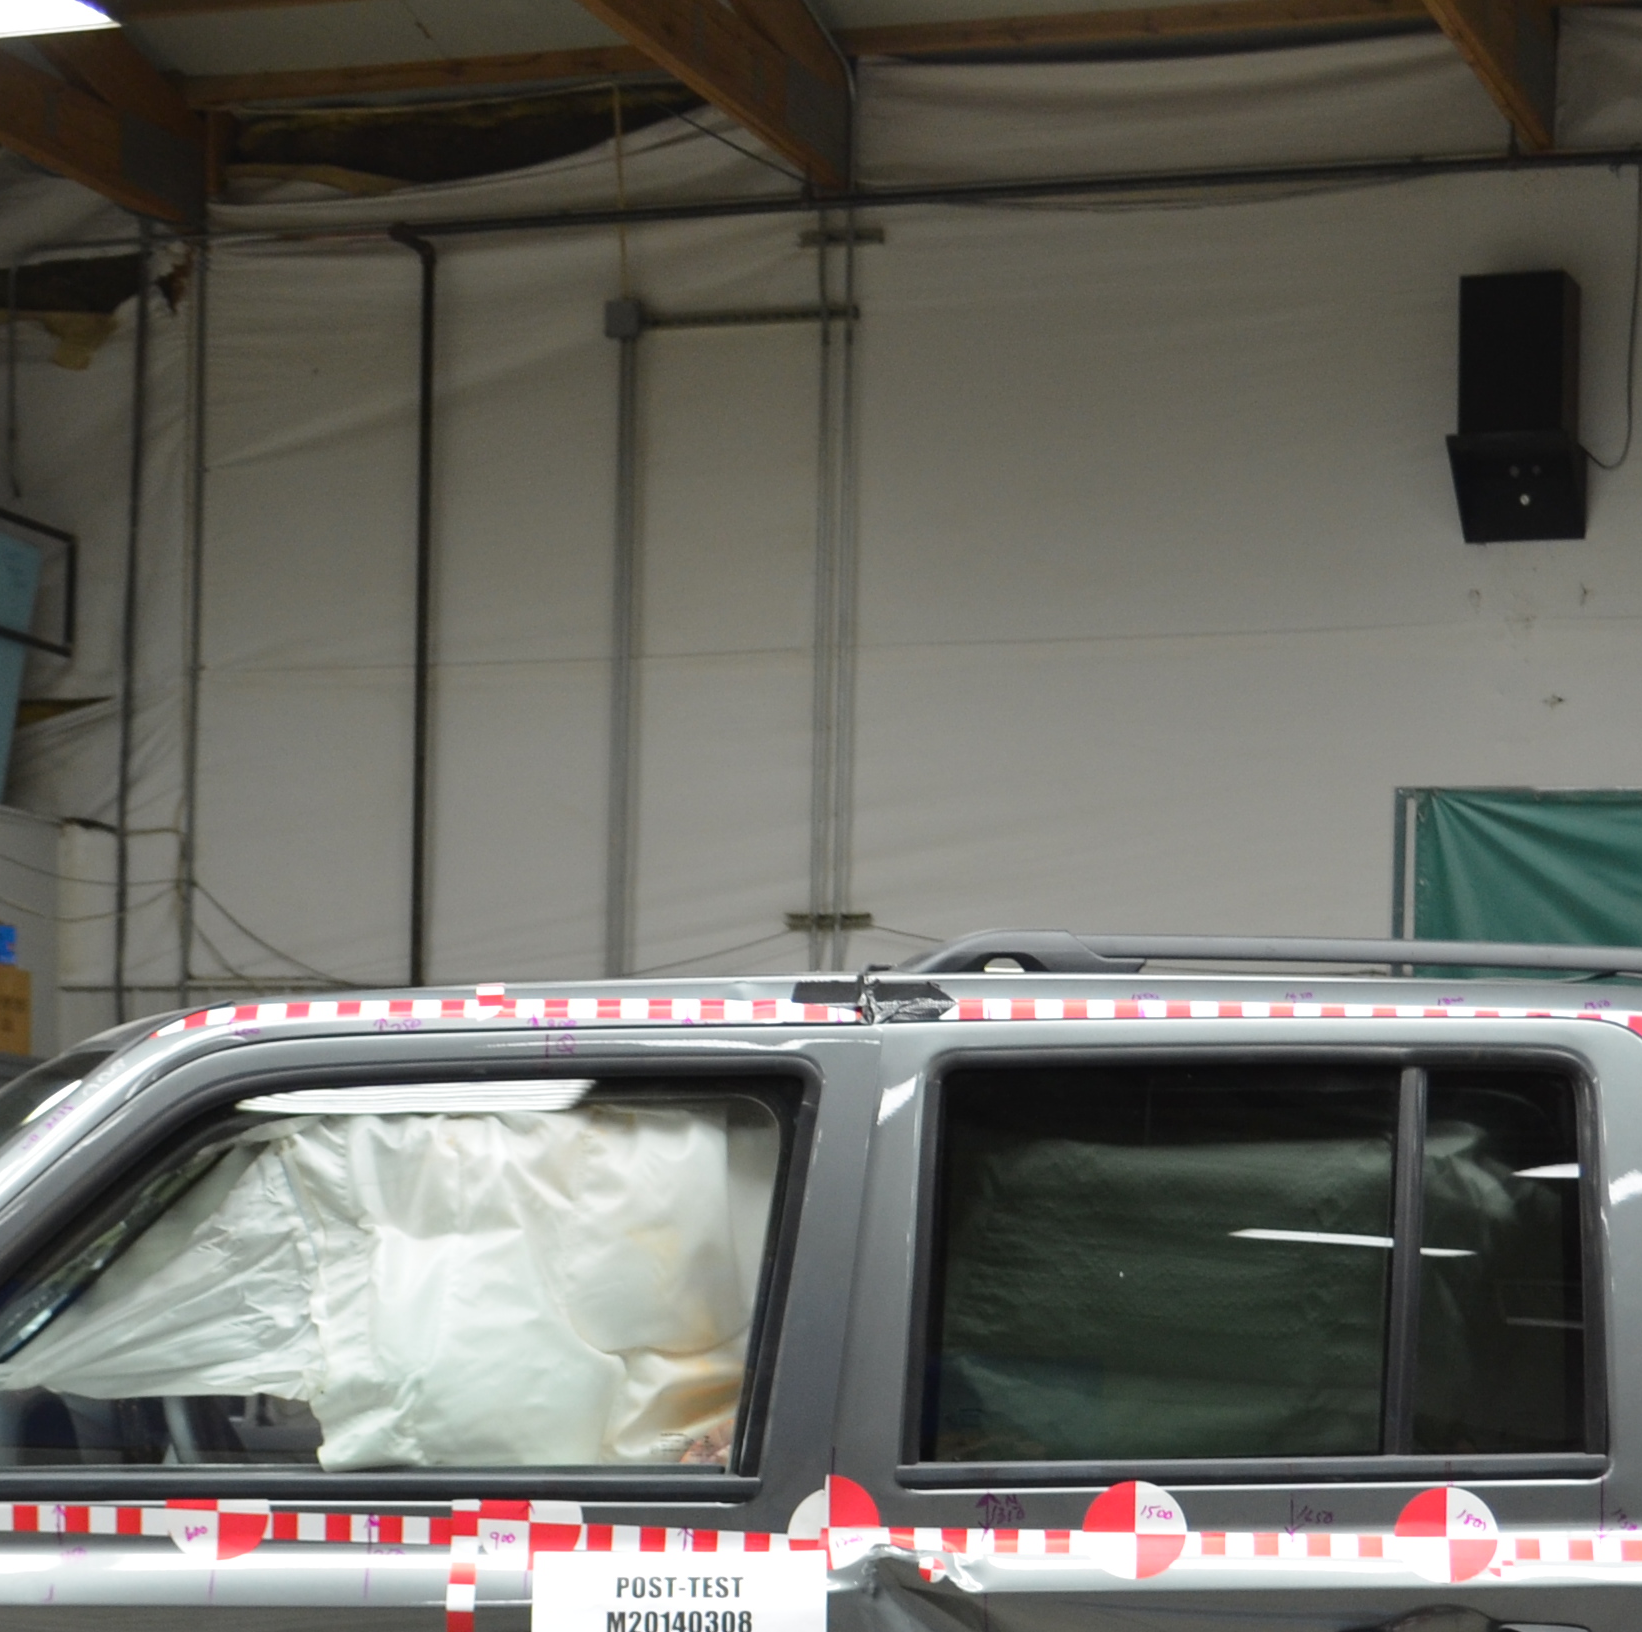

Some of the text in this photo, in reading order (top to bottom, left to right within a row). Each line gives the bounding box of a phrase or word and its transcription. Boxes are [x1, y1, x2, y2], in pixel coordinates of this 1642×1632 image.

[1140, 1505, 1174, 1521] 1500
[489, 1531, 517, 1551] 900
[615, 1576, 745, 1599] POST-TEST
